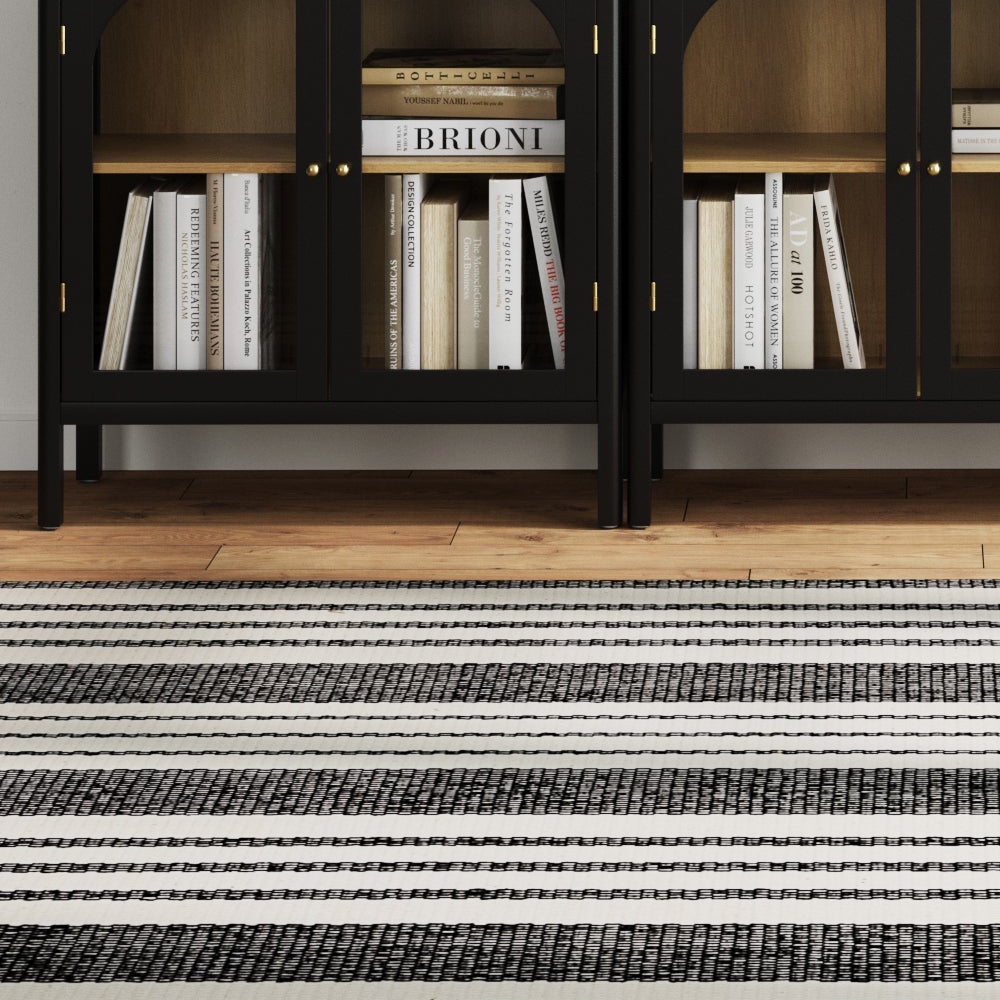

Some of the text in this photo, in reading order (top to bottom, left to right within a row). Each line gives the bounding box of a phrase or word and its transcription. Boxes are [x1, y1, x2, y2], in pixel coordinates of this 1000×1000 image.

[396, 71, 535, 80] BOTTICELLI
[404, 97, 441, 105] YOUSSEF
[414, 127, 543, 150] BRIONI
[407, 181, 415, 267] DESIGN COLLECTION
[533, 190, 545, 223] MILES
[463, 237, 471, 260] Good
[503, 194, 513, 322] The Forgotten Room
[540, 227, 552, 257] REDD
[745, 206, 753, 268] JULIE GARWOOD
[789, 211, 808, 294] AD at 100
[820, 205, 838, 270] FRIDA KAHLO
[191, 208, 199, 342] REDEEMING FEATURES
[545, 259, 557, 281] THE
[770, 217, 778, 346] THE ALLURE OF WOMEN
[210, 241, 219, 356] HAUTE BOHEMIANS
[390, 260, 398, 369] RUINS OF THE AMERICAS
[550, 285, 562, 304] BIG
[745, 286, 754, 347] HOTSHOT
[243, 316, 251, 336] Koch,
[553, 307, 566, 337] BOOK
